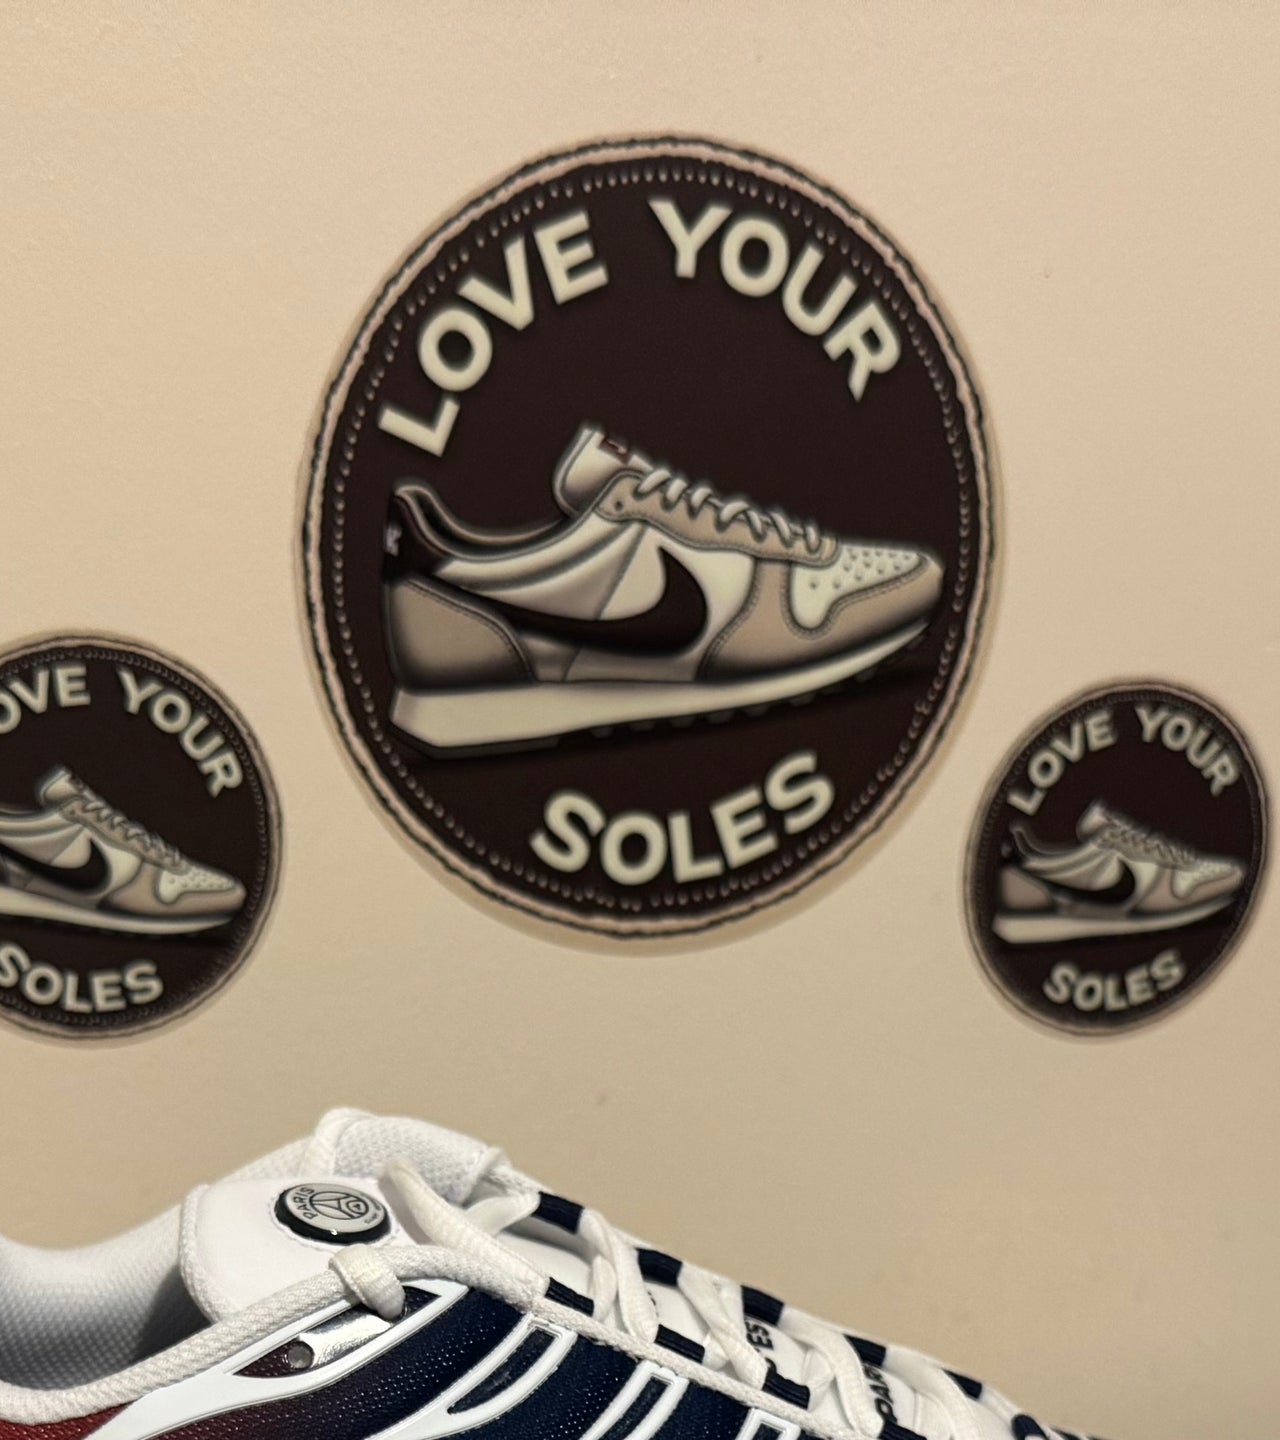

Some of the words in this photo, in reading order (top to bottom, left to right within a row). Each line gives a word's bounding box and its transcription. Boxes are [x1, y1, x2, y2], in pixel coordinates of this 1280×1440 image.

[377, 209, 609, 457] LOVE
[647, 199, 902, 401] YOUR
[116, 667, 243, 798] YOUR
[1007, 707, 1118, 816] LOVE
[1134, 704, 1240, 797] YOUR
[531, 750, 835, 886] SOLES
[1042, 950, 1186, 1012] SOLES
[292, 1186, 318, 1220] PARIS
